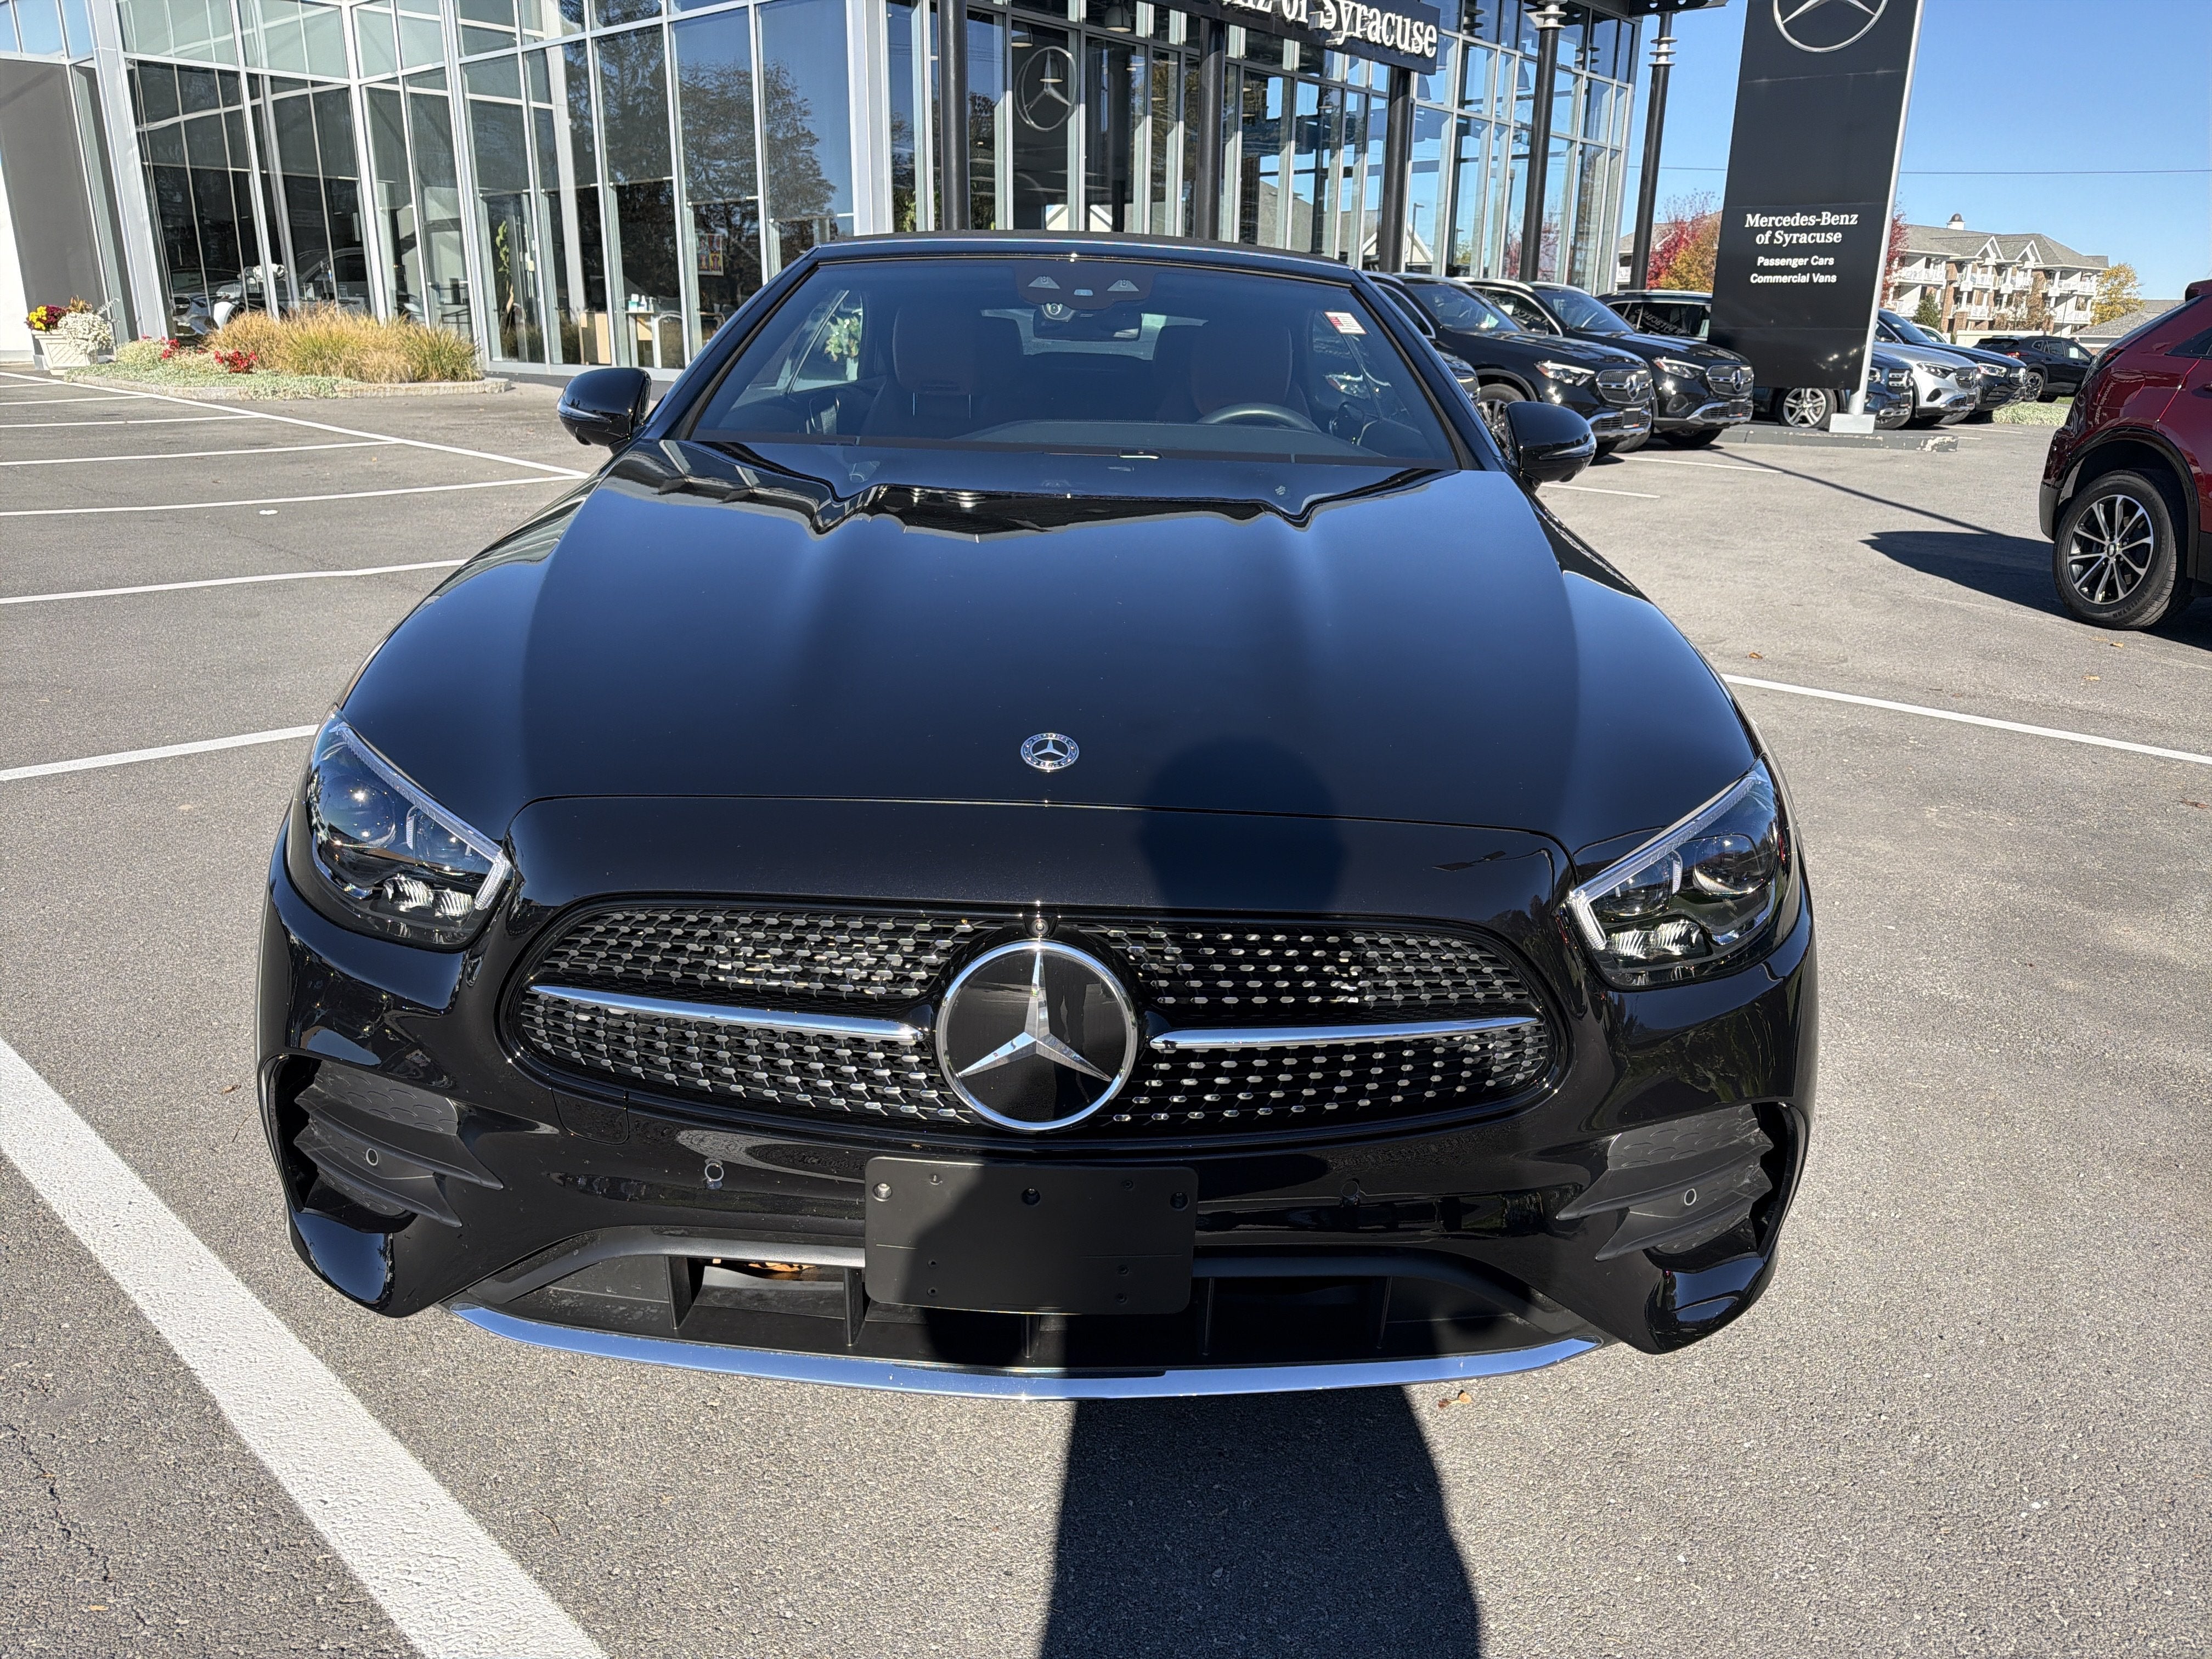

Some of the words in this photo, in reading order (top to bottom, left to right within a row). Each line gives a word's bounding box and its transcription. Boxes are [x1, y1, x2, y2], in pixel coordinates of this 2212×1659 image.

[1321, 0, 1437, 58] Syracuse
[1745, 211, 1858, 228] Mercedes-Benz
[1756, 230, 1771, 245] of
[1774, 231, 1842, 247] Syracuse
[1757, 256, 1809, 268] Passenger
[1811, 256, 1835, 266] Cars
[1750, 273, 1809, 284] Commercial
[1812, 273, 1837, 283] Vans
